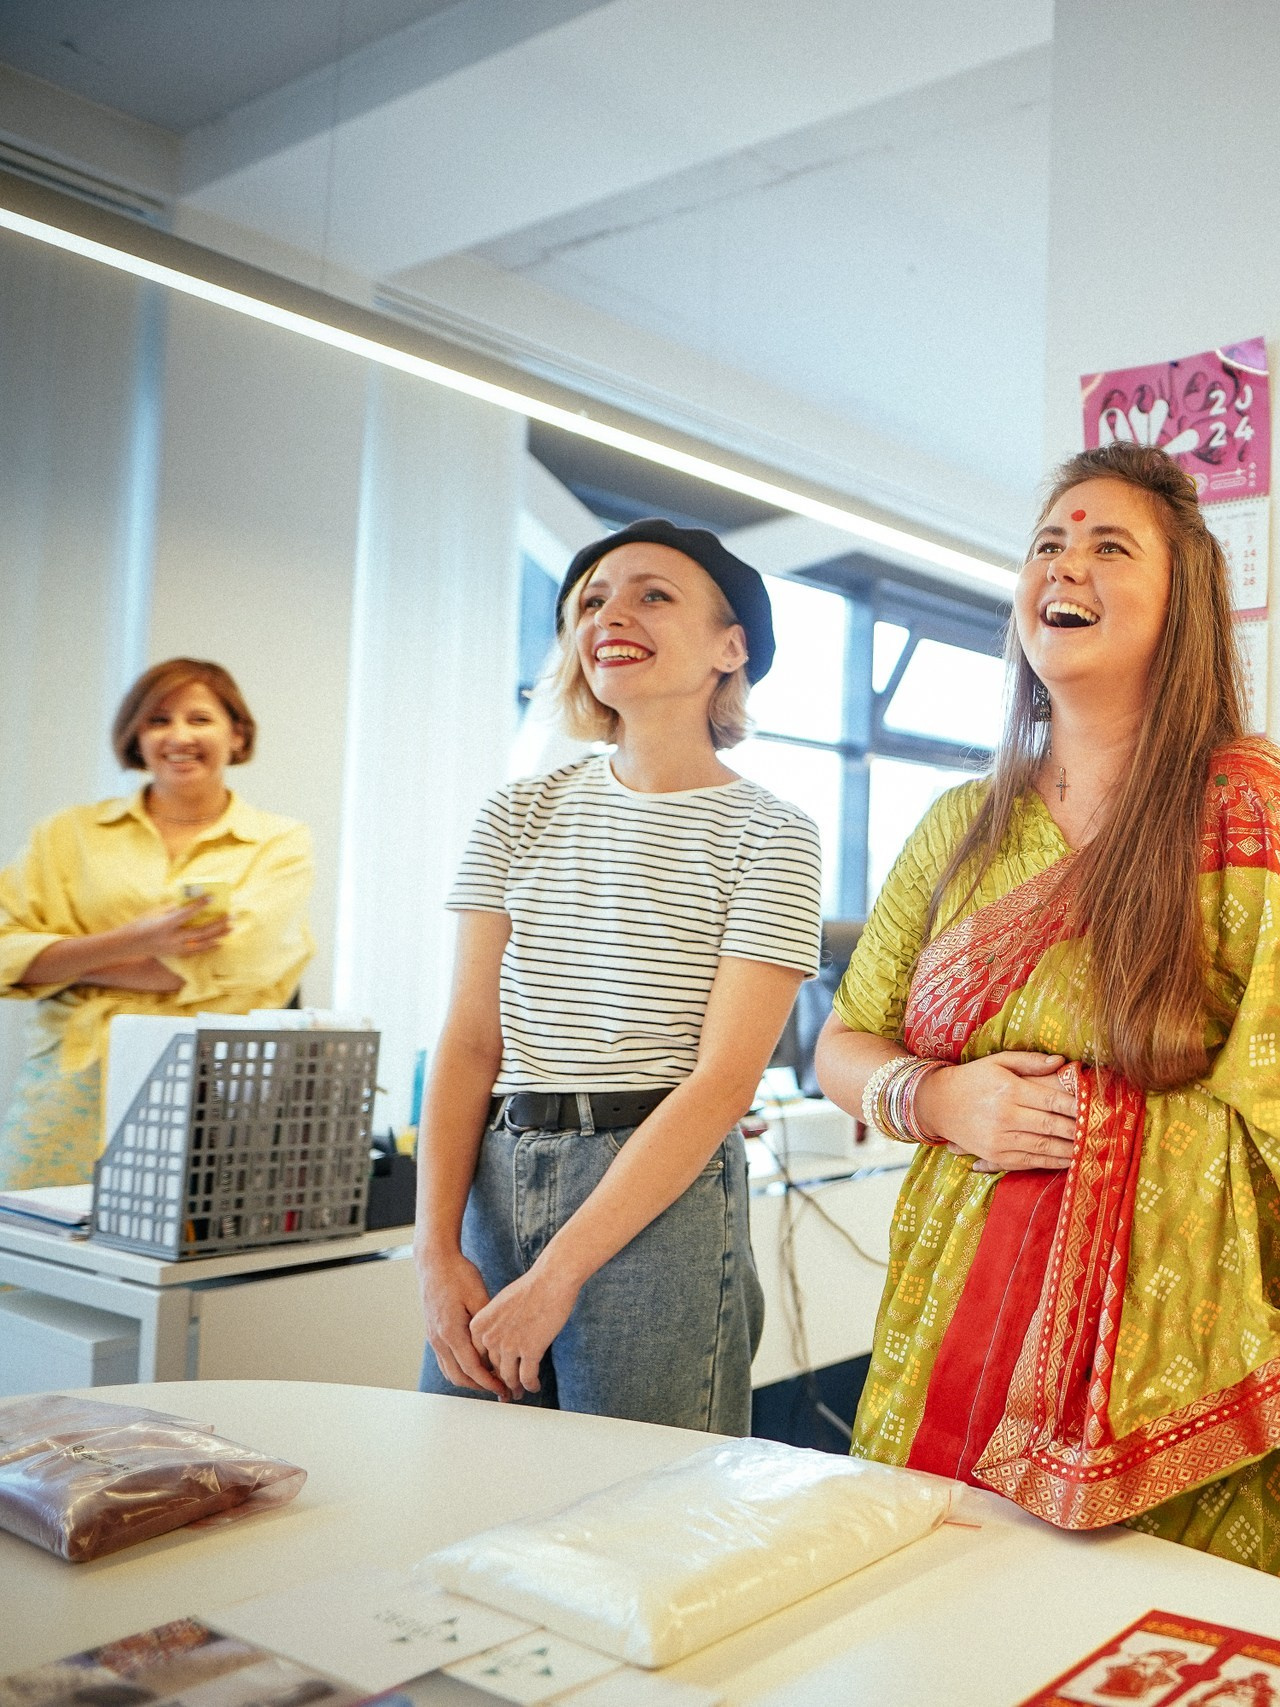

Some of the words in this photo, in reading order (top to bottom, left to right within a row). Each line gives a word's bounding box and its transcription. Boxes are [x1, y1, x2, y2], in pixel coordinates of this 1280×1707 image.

[1208, 416, 1255, 448] 24
[1243, 549, 1257, 558] 14
[1243, 563, 1256, 572] 21
